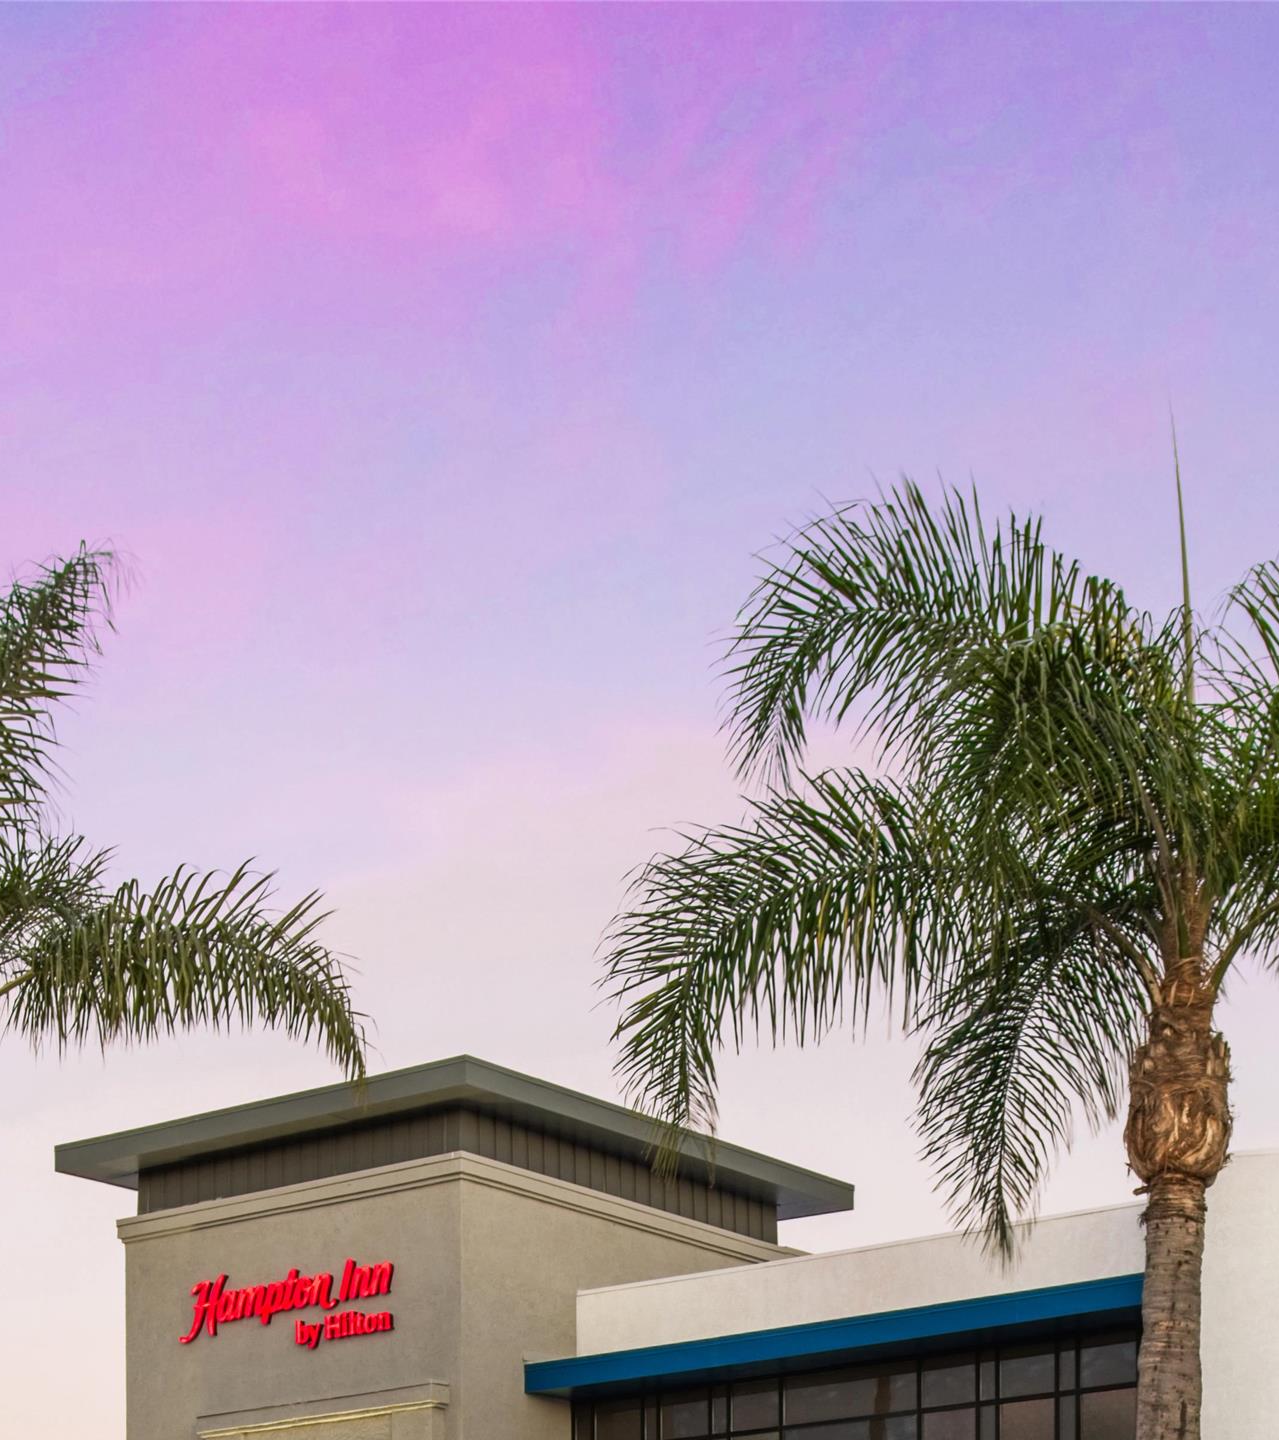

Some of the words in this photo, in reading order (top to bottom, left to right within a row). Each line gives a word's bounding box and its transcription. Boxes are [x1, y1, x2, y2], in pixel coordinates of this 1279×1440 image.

[178, 1268, 339, 1343] Hampton
[339, 1257, 394, 1302] Inn
[295, 1319, 322, 1349] by
[323, 1309, 394, 1340] Hilton
